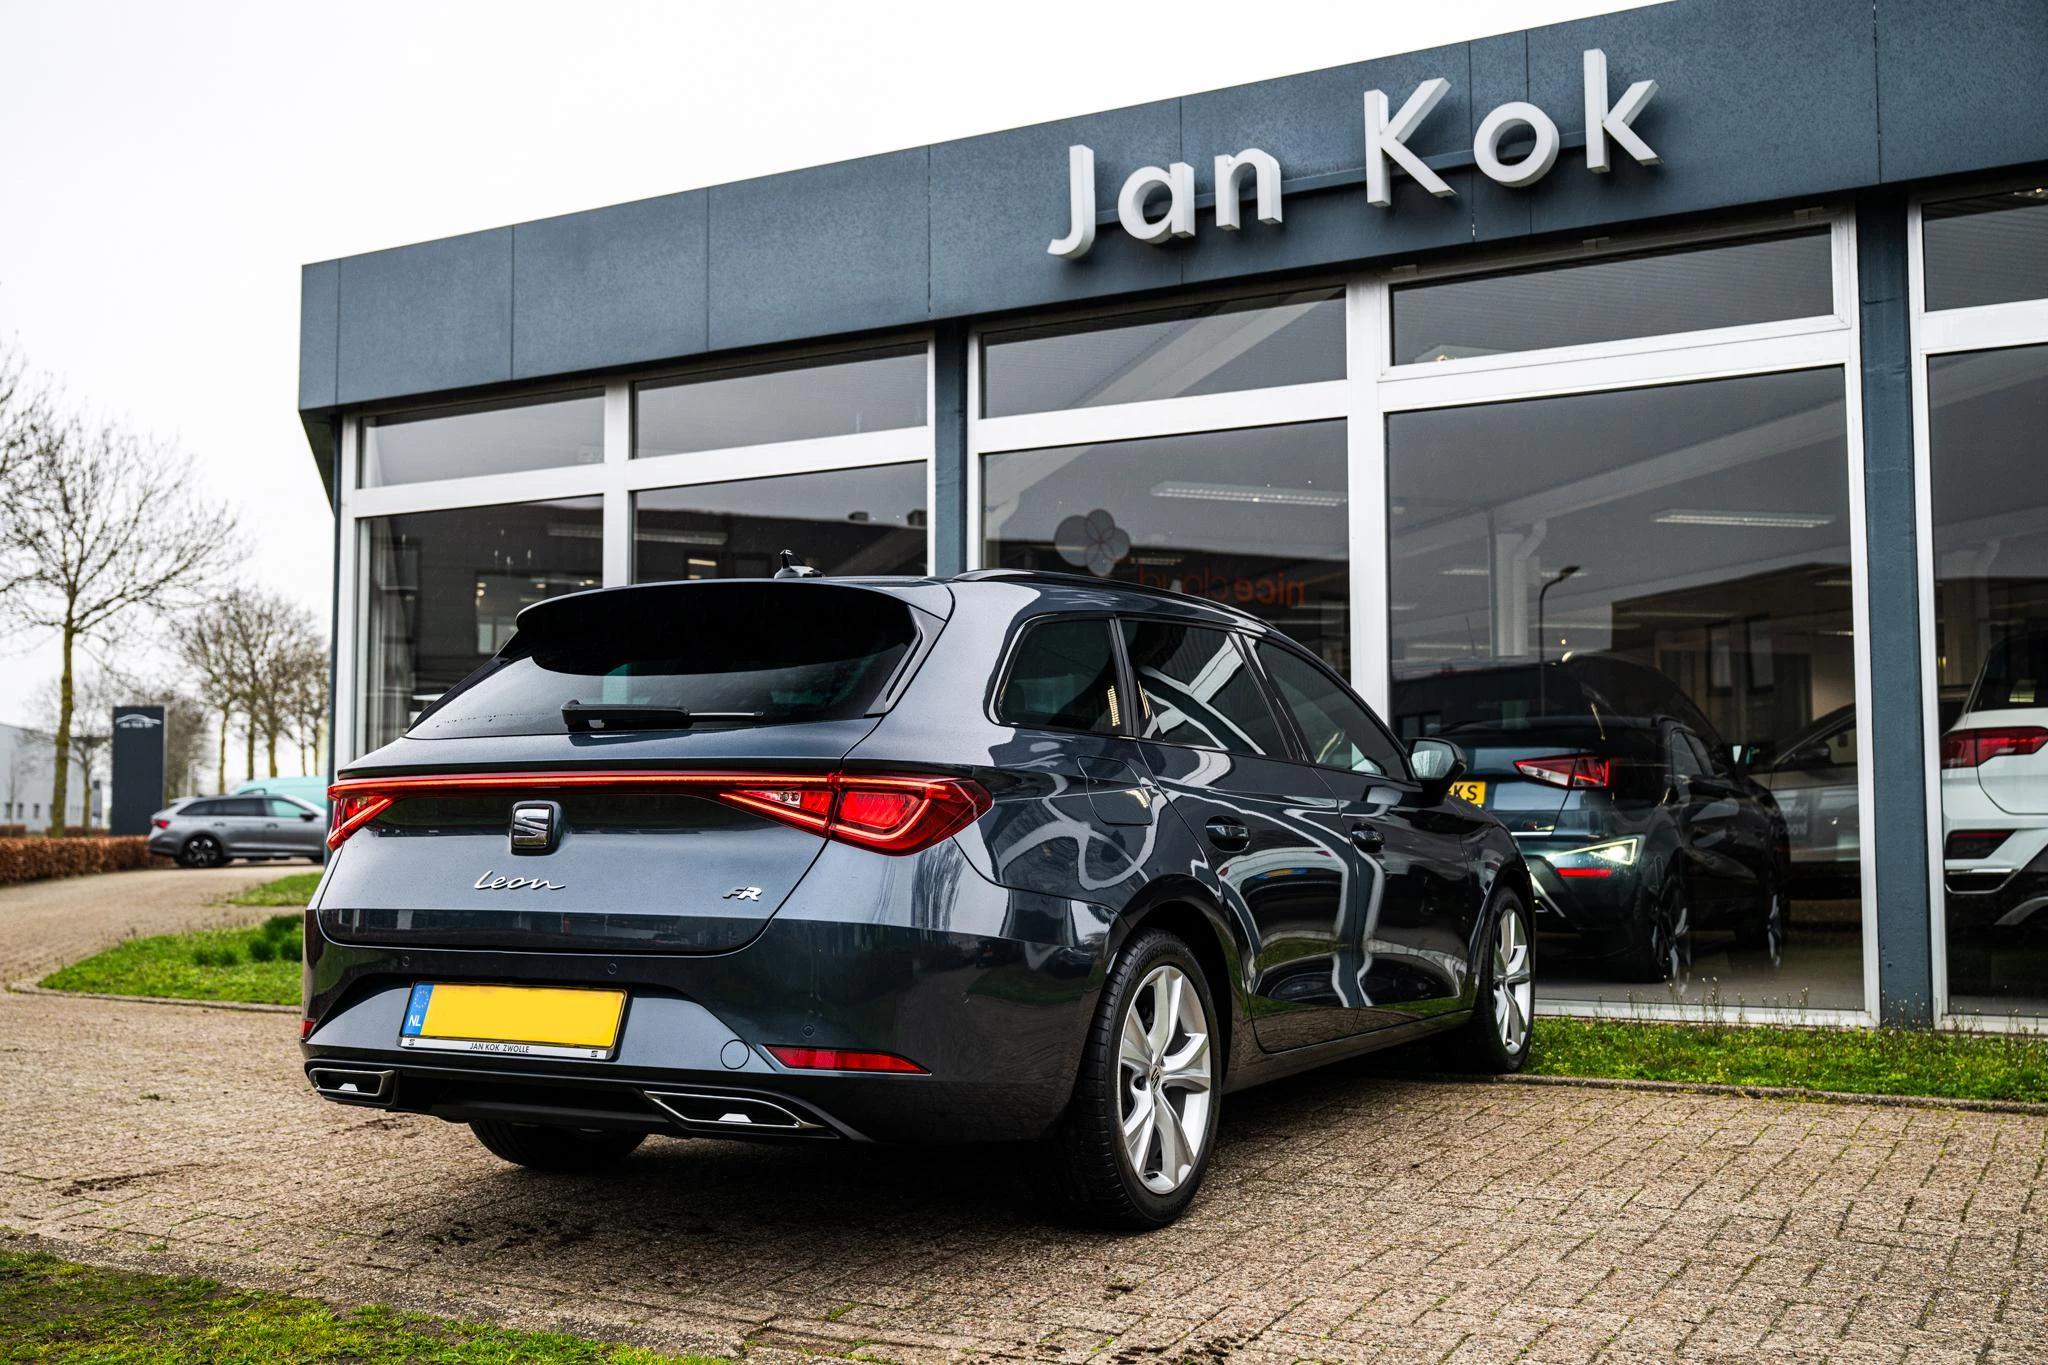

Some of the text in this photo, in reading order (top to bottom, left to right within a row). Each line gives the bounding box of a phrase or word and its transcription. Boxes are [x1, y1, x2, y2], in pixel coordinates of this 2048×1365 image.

[1047, 48, 1663, 258] Jan Kok
[474, 870, 565, 890] Leon
[723, 886, 762, 901] FR
[408, 1014, 421, 1027] NL
[470, 1042, 530, 1053] JAN KOK ZWOLLE
